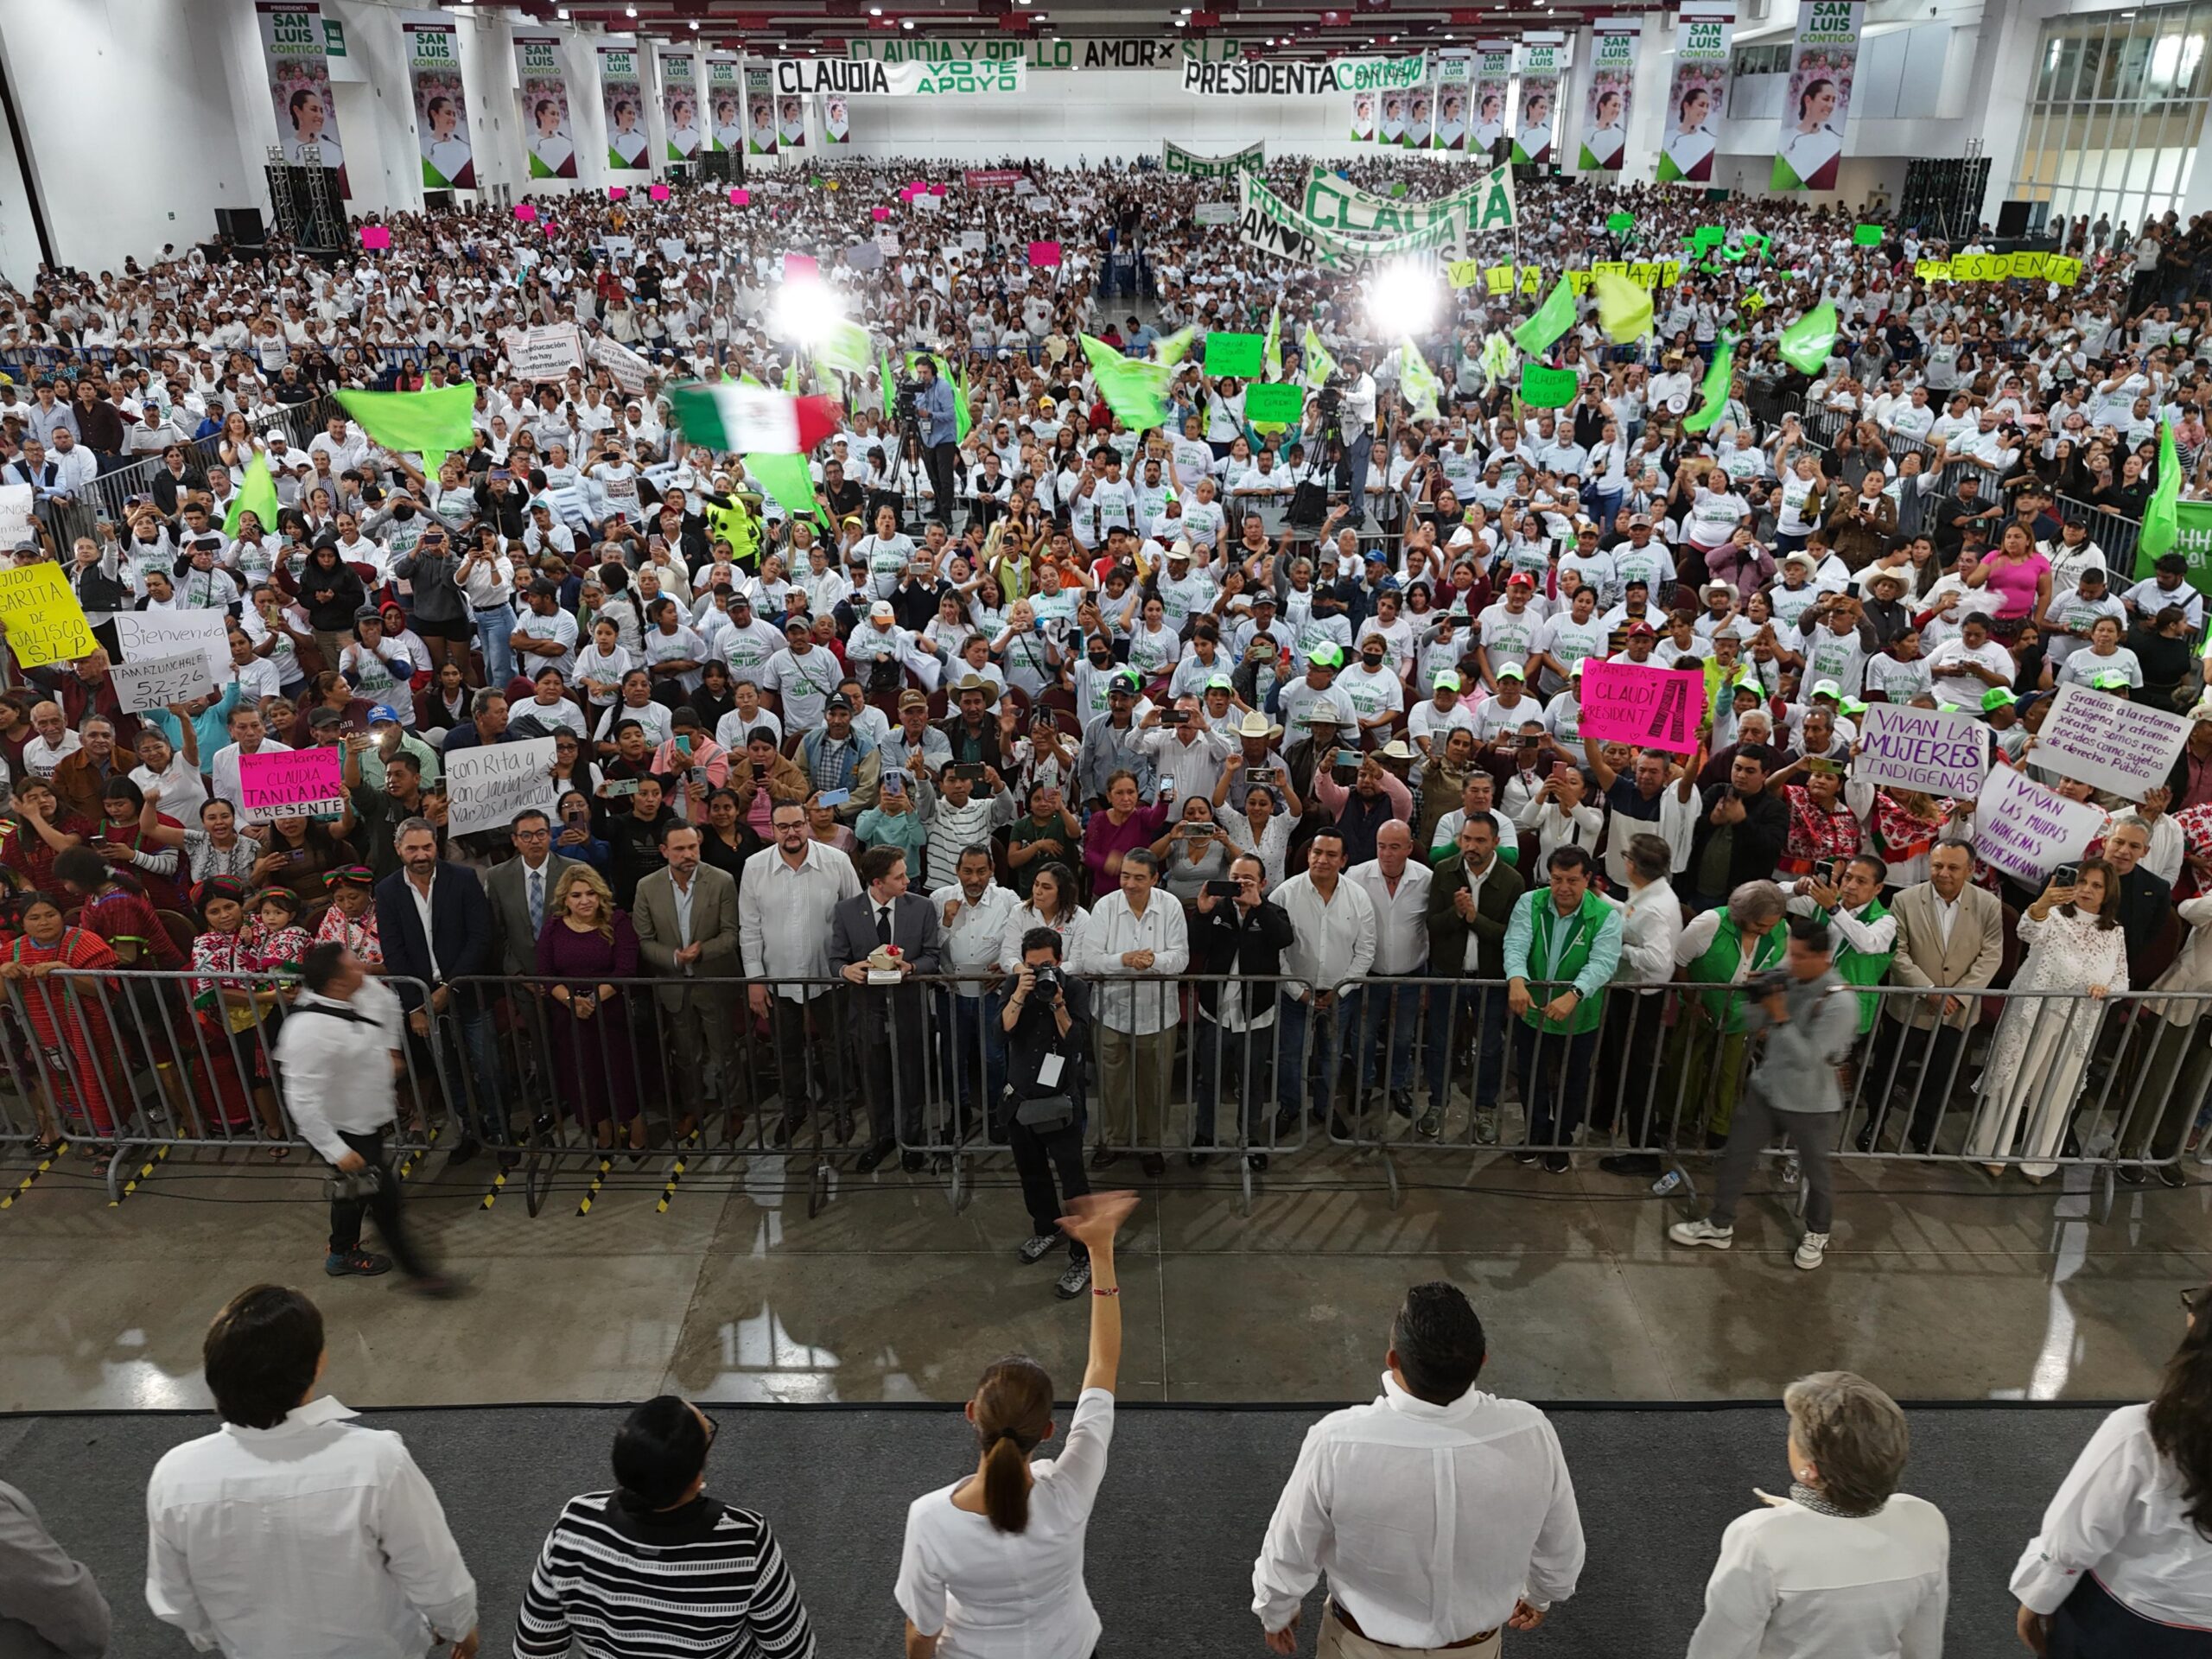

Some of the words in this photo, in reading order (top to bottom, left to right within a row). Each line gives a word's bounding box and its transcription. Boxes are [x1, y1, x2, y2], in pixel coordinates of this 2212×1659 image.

[1813, 3, 1852, 16] SAN
[273, 13, 309, 28] SAN
[1809, 18, 1850, 32] LUIS
[274, 29, 314, 42] LUIS
[1689, 24, 1722, 35] SAN
[416, 33, 447, 44] SAN
[1603, 37, 1630, 47] SAN
[1688, 37, 1721, 48] LUIS
[1800, 34, 1856, 43] CONTIGO
[270, 44, 322, 54] CONTIGO
[417, 46, 449, 58] LUIS
[524, 46, 552, 55] SAN
[962, 41, 980, 60] Y
[1084, 40, 1156, 67] AMOR
[1530, 48, 1554, 57] SAN
[1601, 47, 1630, 58] LUIS
[1679, 50, 1726, 59] CONTIGO
[412, 58, 457, 67] CONTIGO
[525, 56, 555, 66] LUIS
[607, 54, 630, 62] SAN
[1529, 57, 1554, 67] LUIS
[607, 63, 632, 72] LUIS
[926, 60, 973, 76] YO
[979, 60, 1017, 73] TE
[1185, 61, 1339, 94] PRESIDENTA
[1338, 55, 1424, 90] Contigo
[1483, 62, 1505, 71] LUIS
[779, 60, 890, 93] CLAUDIA
[916, 75, 1017, 94] APOYO
[1166, 149, 1263, 176] Claudia
[1305, 181, 1512, 233] CLAUDIA
[1249, 177, 1314, 236] POLLO
[1344, 216, 1456, 258] CLAUDIA
[1239, 207, 1316, 264] AMR
[1569, 261, 1679, 292] RRIAGA
[528, 340, 567, 353] educación
[537, 353, 552, 362] hay
[608, 357, 621, 366] San
[622, 362, 636, 371] Luis
[0, 569, 34, 588] JIDO
[29, 610, 48, 625] DE
[12, 619, 84, 648] JALISCO
[118, 616, 226, 648] Bienvenida
[1493, 642, 1507, 652] SAN
[1509, 644, 1526, 654] LUIS
[1560, 650, 1576, 660] SAN
[745, 657, 760, 666] LUIS
[1815, 661, 1827, 673] SAN
[1827, 664, 1844, 676] LUIS
[1599, 663, 1657, 681] TANLAJAS
[137, 670, 204, 696] 52-26
[377, 679, 394, 690] LUIS
[132, 690, 188, 709] SNTE
[1360, 702, 1376, 714] LUIS
[2069, 690, 2114, 713] Gracias
[2117, 709, 2125, 717] a
[2126, 708, 2138, 720] la
[2139, 712, 2182, 734] reforma
[2062, 701, 2113, 727] Indígena
[2118, 722, 2126, 733] y
[2129, 724, 2174, 744] afrome-
[1947, 721, 1984, 746] LAS
[2057, 715, 2097, 734] xicana
[2103, 729, 2139, 748] somos
[2141, 743, 2169, 757] reco-
[1862, 732, 1980, 769] MUJERES
[2046, 736, 2061, 747] de
[2063, 742, 2106, 765] derecho
[2052, 724, 2096, 747] nocidos
[2096, 741, 2126, 758] como
[2126, 752, 2164, 771] sujetos
[273, 749, 338, 766] Estamos
[484, 751, 521, 774] Rita
[522, 752, 535, 783] y
[266, 767, 321, 786] CLAUDIA
[244, 781, 341, 806] TANLAJAS
[452, 786, 474, 804] con
[510, 783, 553, 810] avanzar
[253, 800, 342, 819] PRESENTE
[1999, 798, 2023, 821] LAS
[2024, 814, 2069, 844] MUJERES
[1989, 817, 2042, 856] INDIGENAS
